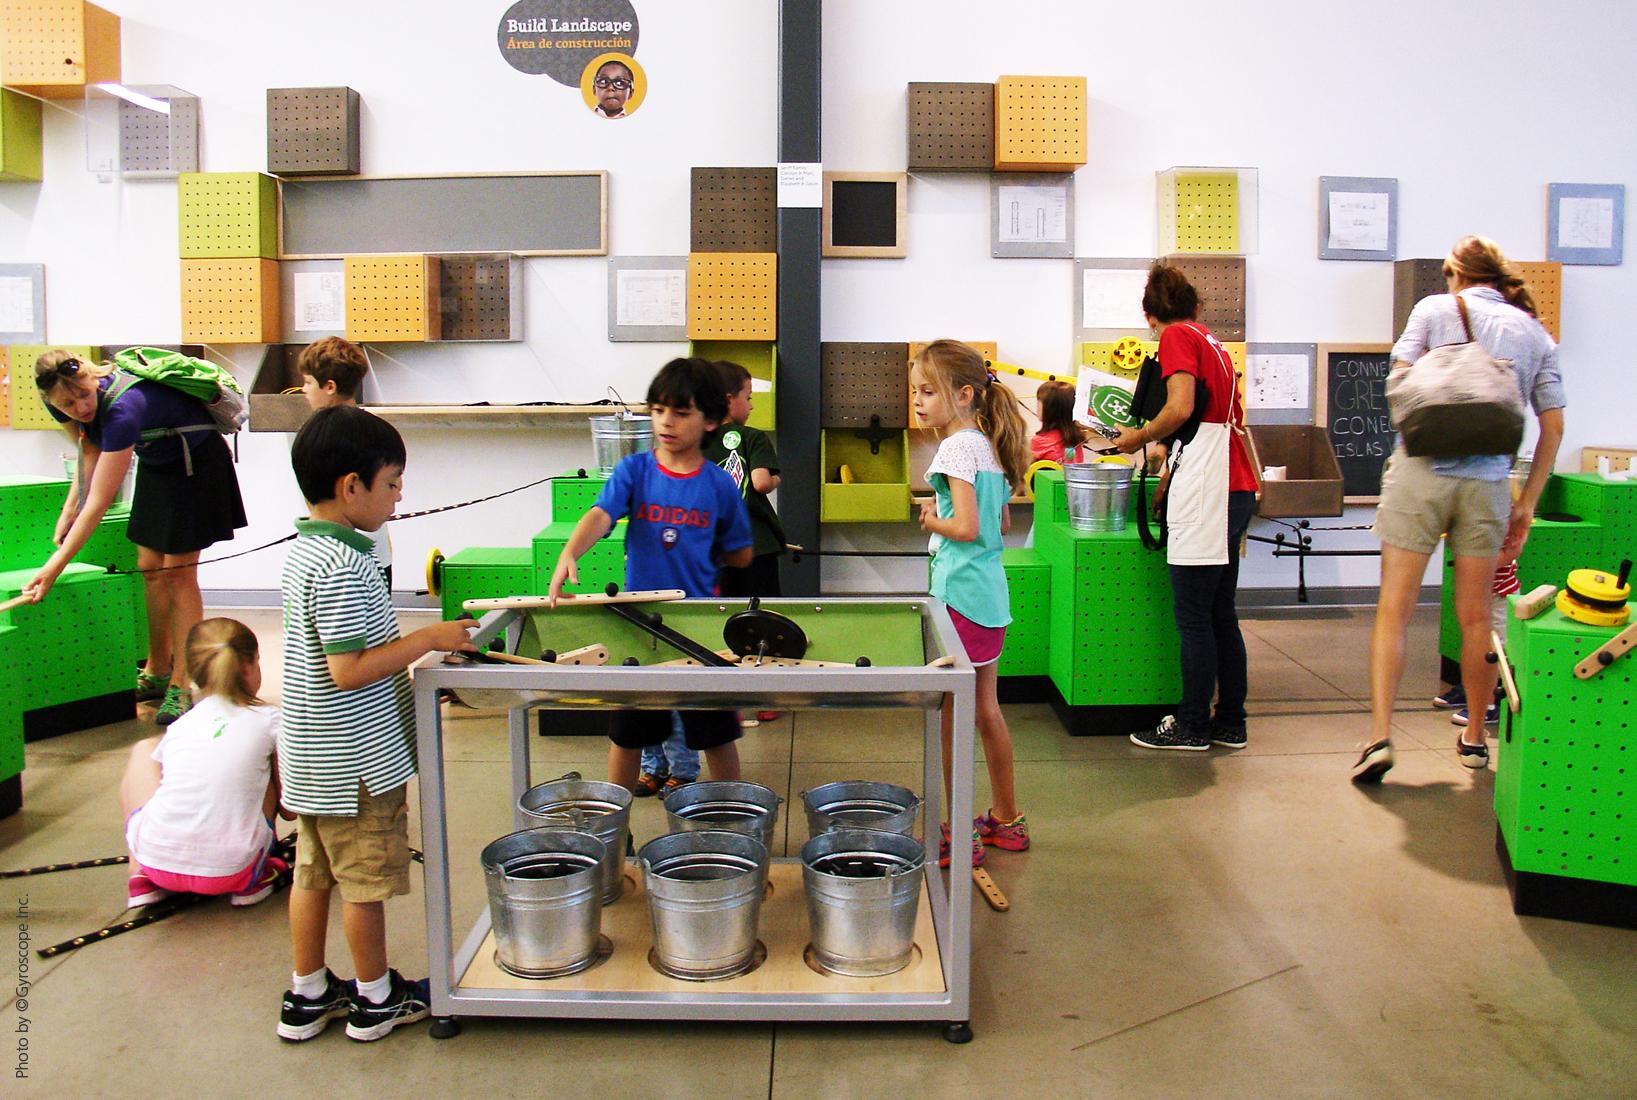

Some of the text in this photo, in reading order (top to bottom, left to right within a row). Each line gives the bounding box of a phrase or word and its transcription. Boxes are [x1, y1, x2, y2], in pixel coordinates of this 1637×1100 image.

[507, 18, 633, 35] Build Landscape
[507, 37, 632, 49] Área de construcción
[1336, 360, 1390, 378] CONNE
[1334, 379, 1383, 411] GRE
[1333, 415, 1399, 435] CONEC
[1335, 442, 1384, 458] ISLAS
[635, 503, 711, 529] ADIDAS
